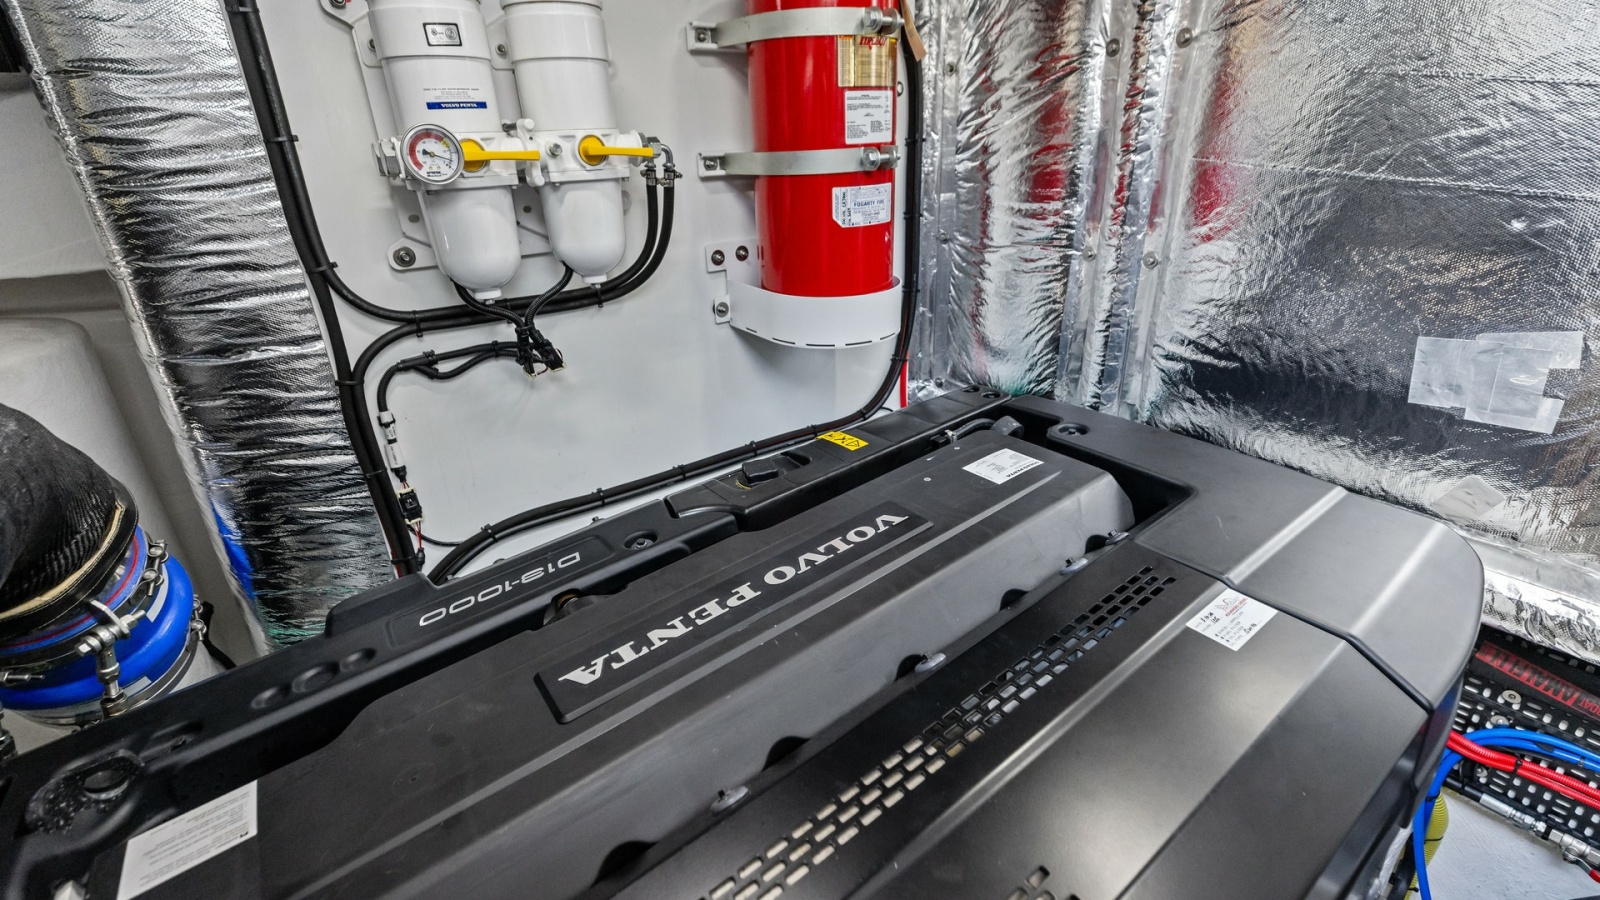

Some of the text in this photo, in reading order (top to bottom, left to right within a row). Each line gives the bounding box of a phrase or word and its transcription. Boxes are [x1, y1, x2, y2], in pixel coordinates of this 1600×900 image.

[1006, 467, 1024, 477] PENTA
[419, 552, 580, 627] D13-1000
[558, 514, 909, 685] VOLVO PENTA
